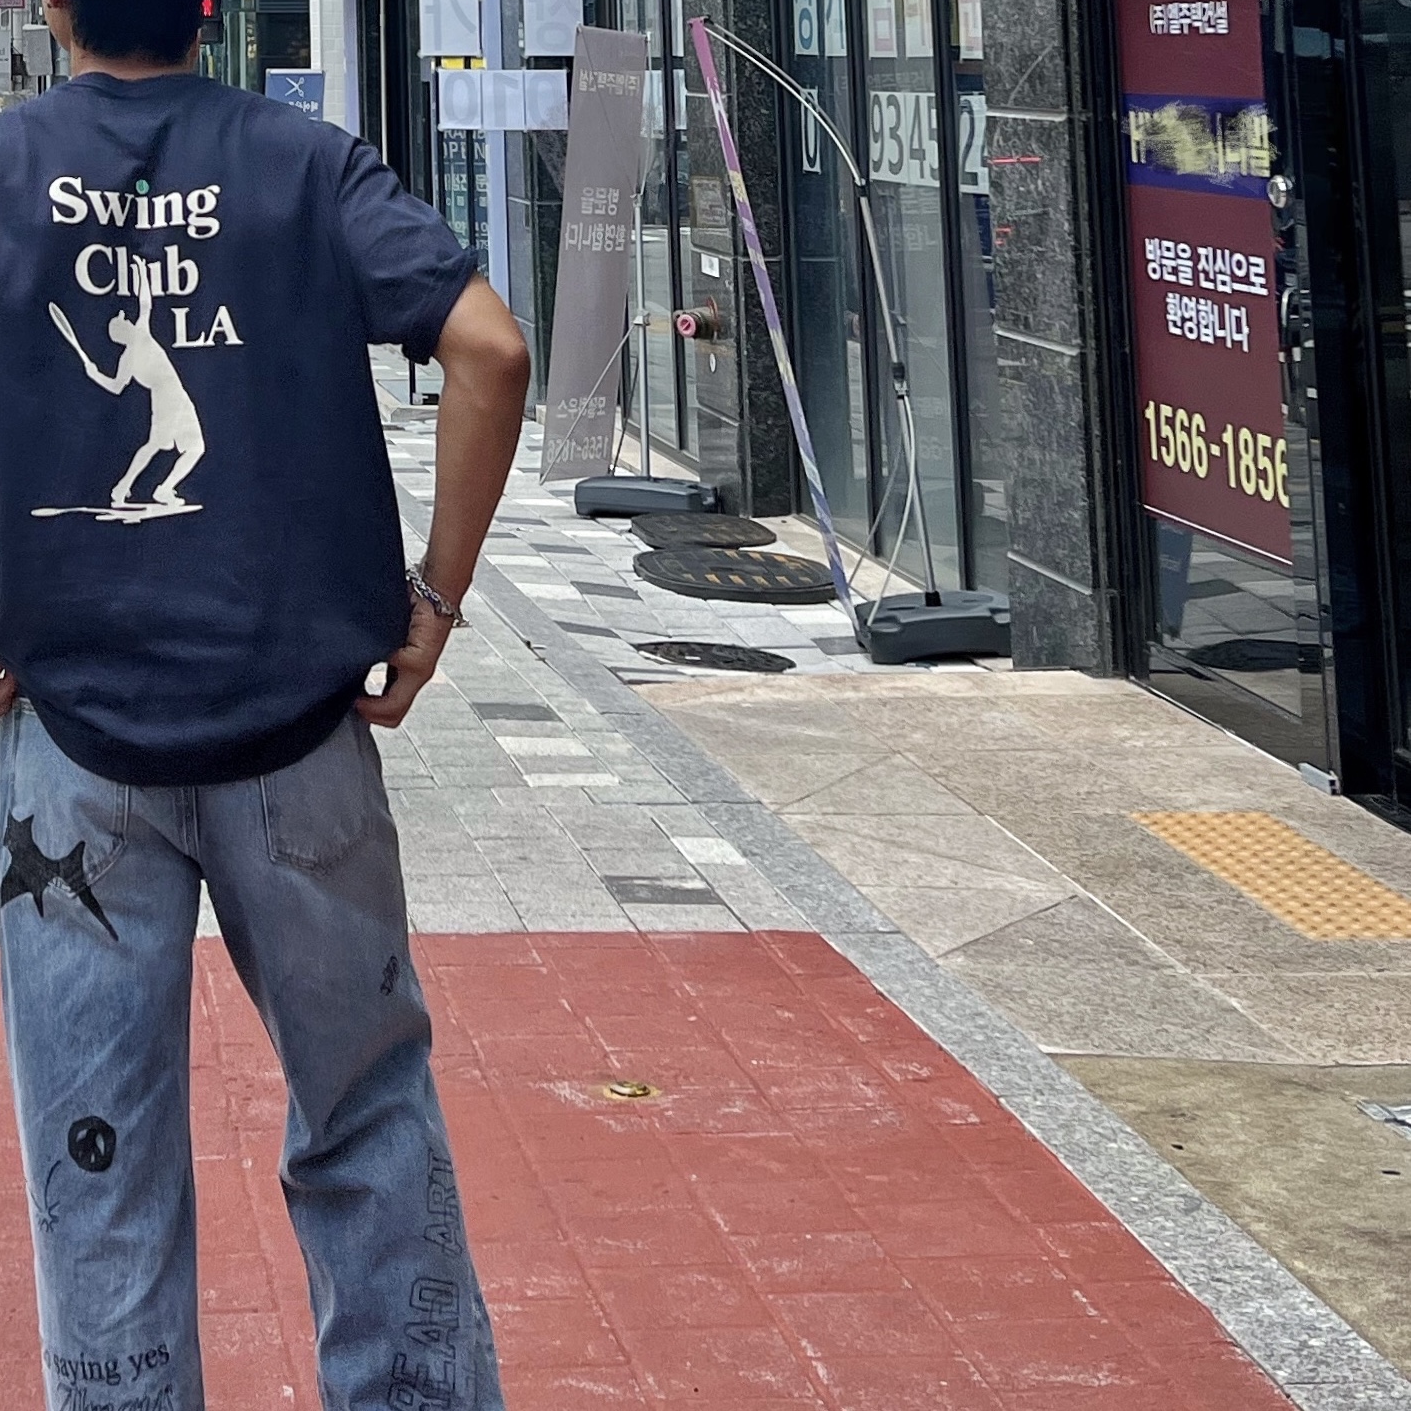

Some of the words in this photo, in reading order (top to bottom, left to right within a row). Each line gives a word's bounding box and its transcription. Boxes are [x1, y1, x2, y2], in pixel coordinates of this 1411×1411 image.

[48, 175, 222, 239] Swing
[75, 243, 200, 297] Club
[1144, 236, 1194, 287] 방문을
[1196, 245, 1269, 297] 진심으로
[170, 305, 244, 349] LA
[1164, 291, 1250, 353] 환영합니다
[1144, 399, 1290, 509] 1566-1856
[422, 1144, 463, 1254] ART
[53, 1351, 122, 1387] saying
[127, 1343, 170, 1382] yes
